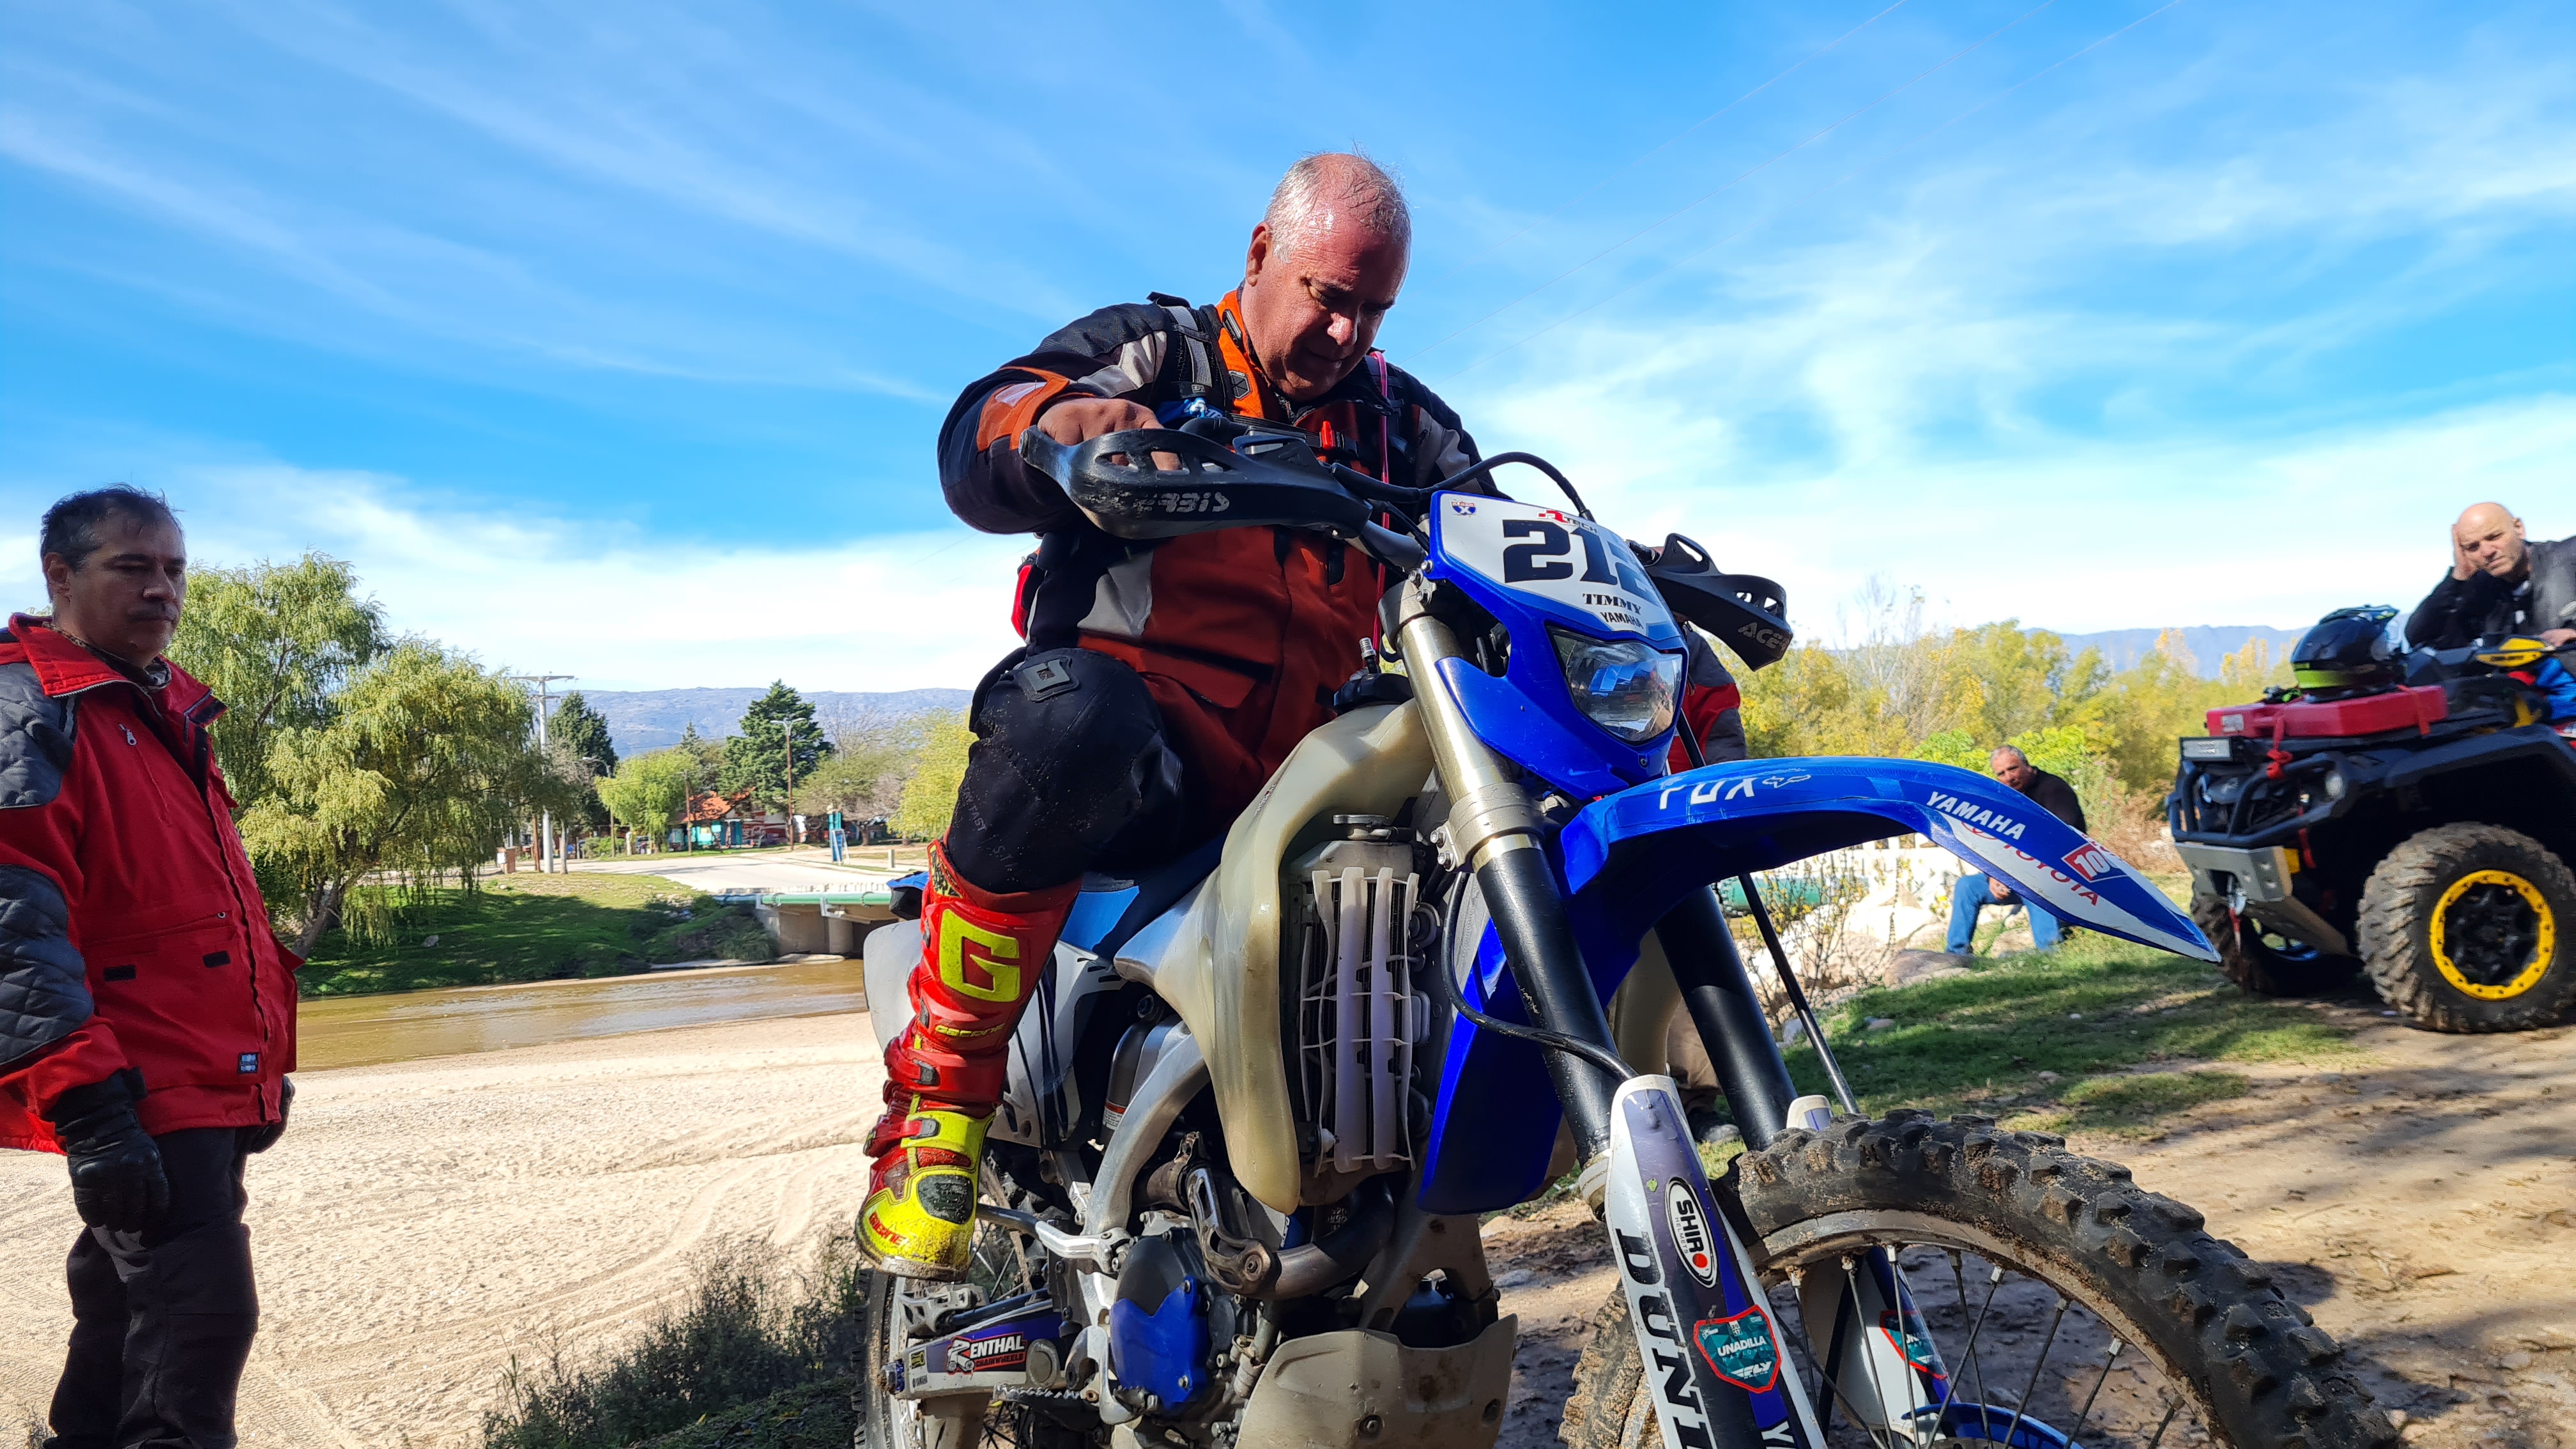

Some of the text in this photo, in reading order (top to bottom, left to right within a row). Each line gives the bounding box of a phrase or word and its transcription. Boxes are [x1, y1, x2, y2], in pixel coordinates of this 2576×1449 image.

[1583, 593, 1641, 615] TIMMY
[1600, 611, 1644, 629] YAMAHA
[1926, 791, 2026, 839] YAMAHA
[939, 908, 1020, 1002] G
[1675, 1217, 1689, 1254] HELMETS
[947, 1335, 1025, 1372] RENTHAL
[1717, 1335, 1767, 1356] UNADILLA
